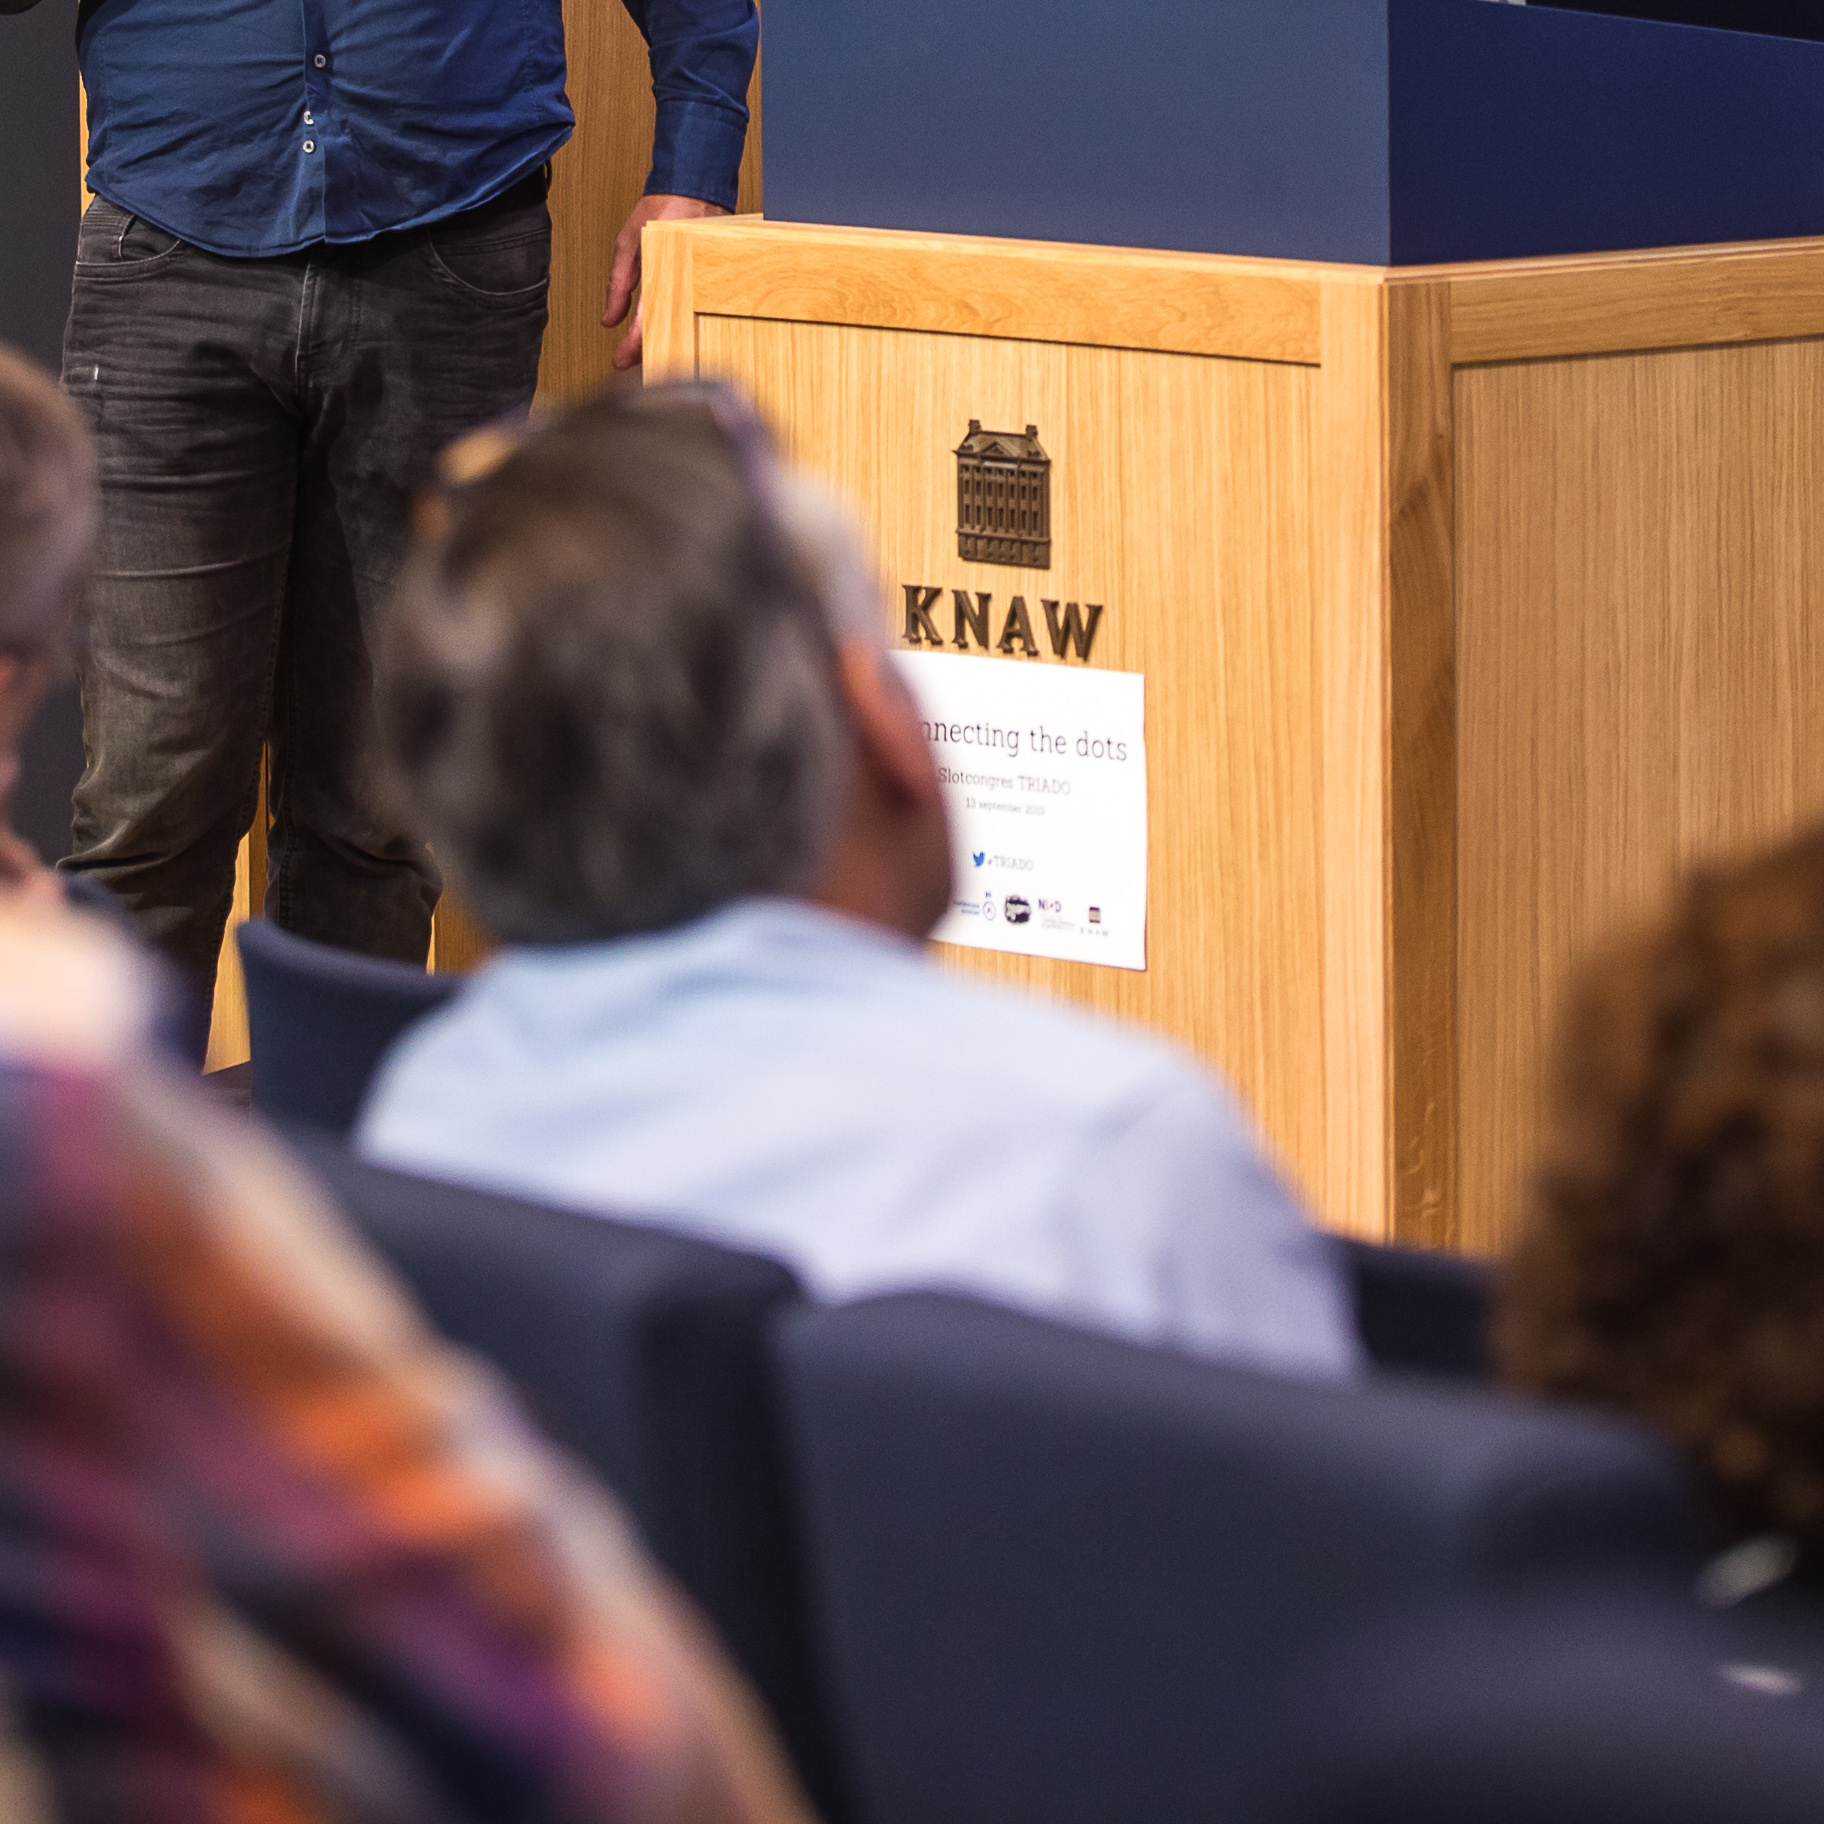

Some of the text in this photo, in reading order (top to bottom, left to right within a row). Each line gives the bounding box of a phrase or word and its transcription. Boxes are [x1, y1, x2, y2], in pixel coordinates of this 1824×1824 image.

[901, 584, 1105, 661] KNAW
[922, 721, 1128, 762] nnecting the dots
[938, 767, 1072, 795] Slotcongres TRIADO
[966, 797, 976, 808] 13
[979, 801, 1022, 814] september
